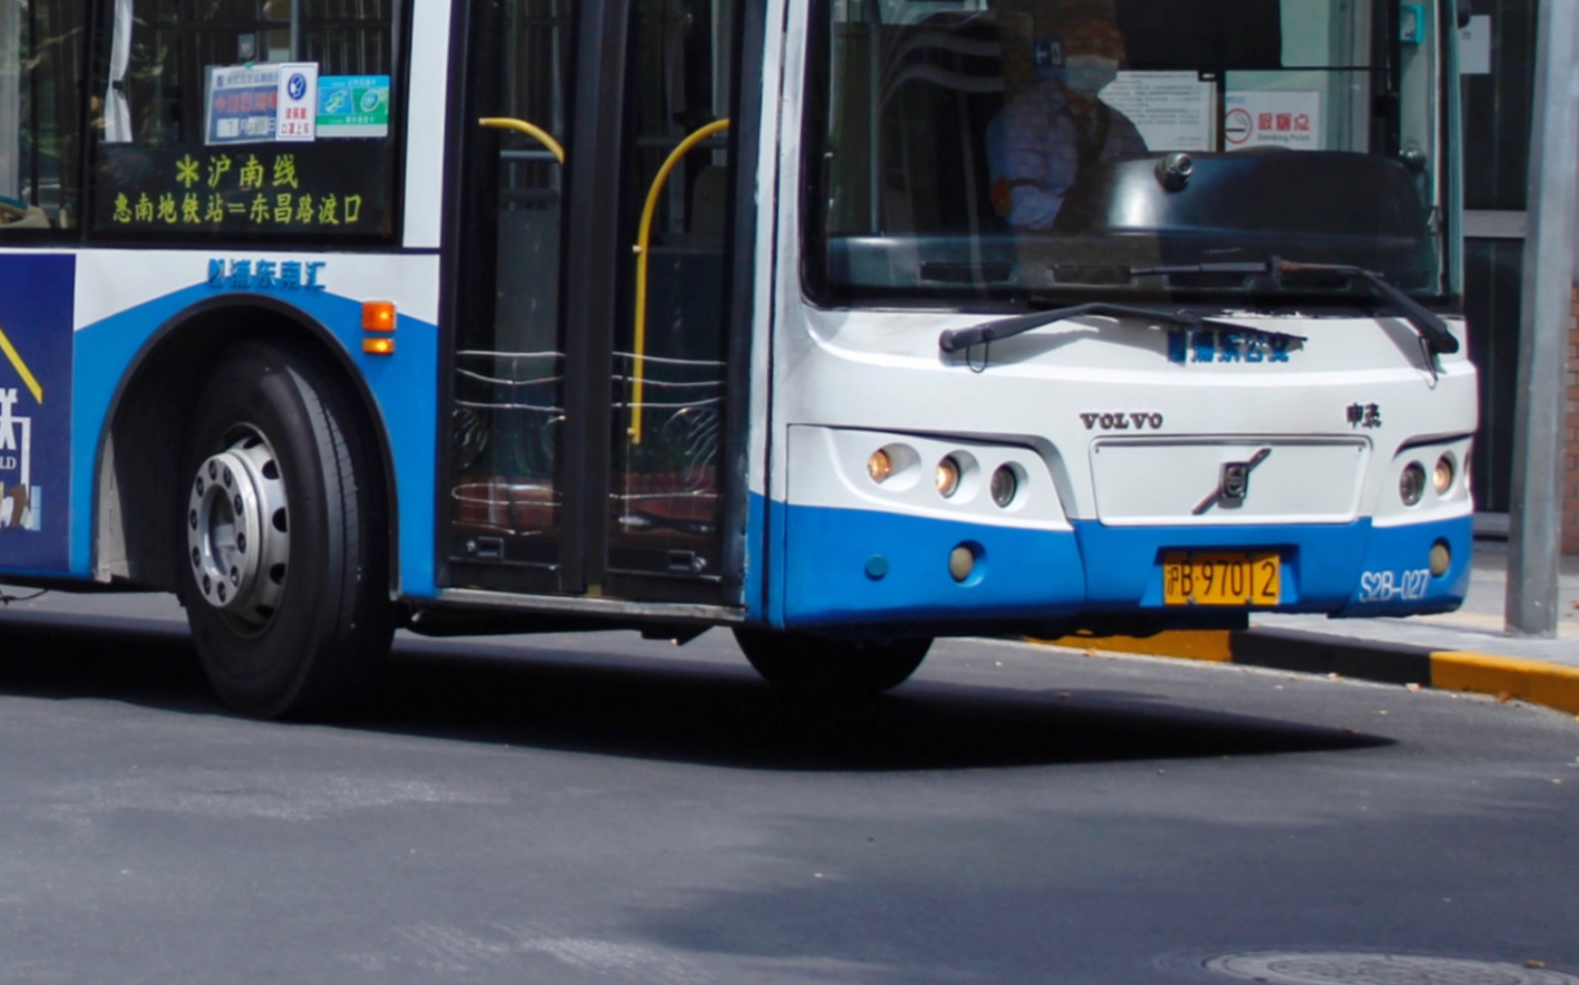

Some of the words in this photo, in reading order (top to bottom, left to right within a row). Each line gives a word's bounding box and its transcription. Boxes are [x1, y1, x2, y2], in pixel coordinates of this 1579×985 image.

[207, 154, 299, 189] 沪南线
[1080, 412, 1164, 430] VOLVO
[1359, 569, 1430, 603] S2B-027
